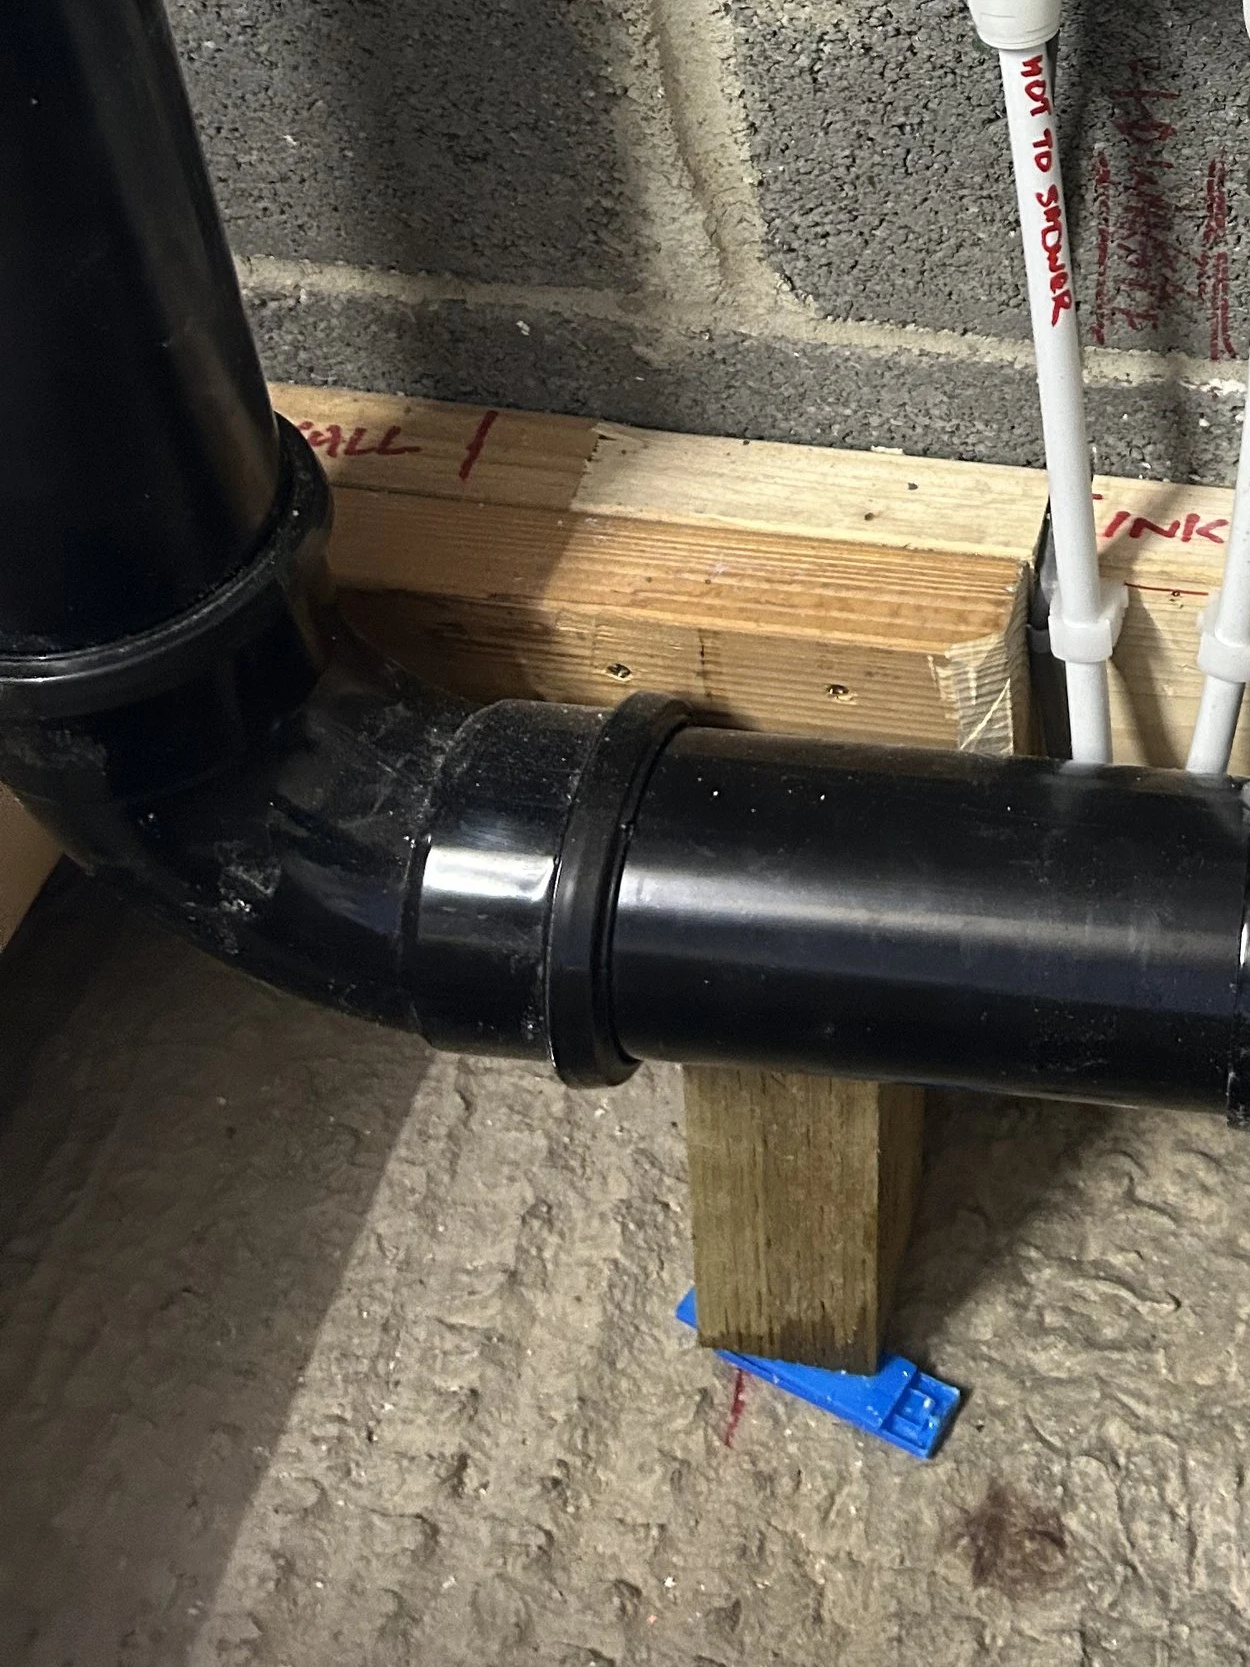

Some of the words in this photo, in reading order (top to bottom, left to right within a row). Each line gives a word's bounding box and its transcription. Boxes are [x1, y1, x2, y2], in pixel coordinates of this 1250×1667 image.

[1020, 54, 1052, 117] HOT
[1032, 128, 1053, 173] TO
[1035, 184, 1073, 328] SHOWER
[299, 420, 422, 458] ALL
[1092, 494, 1229, 543] INK
